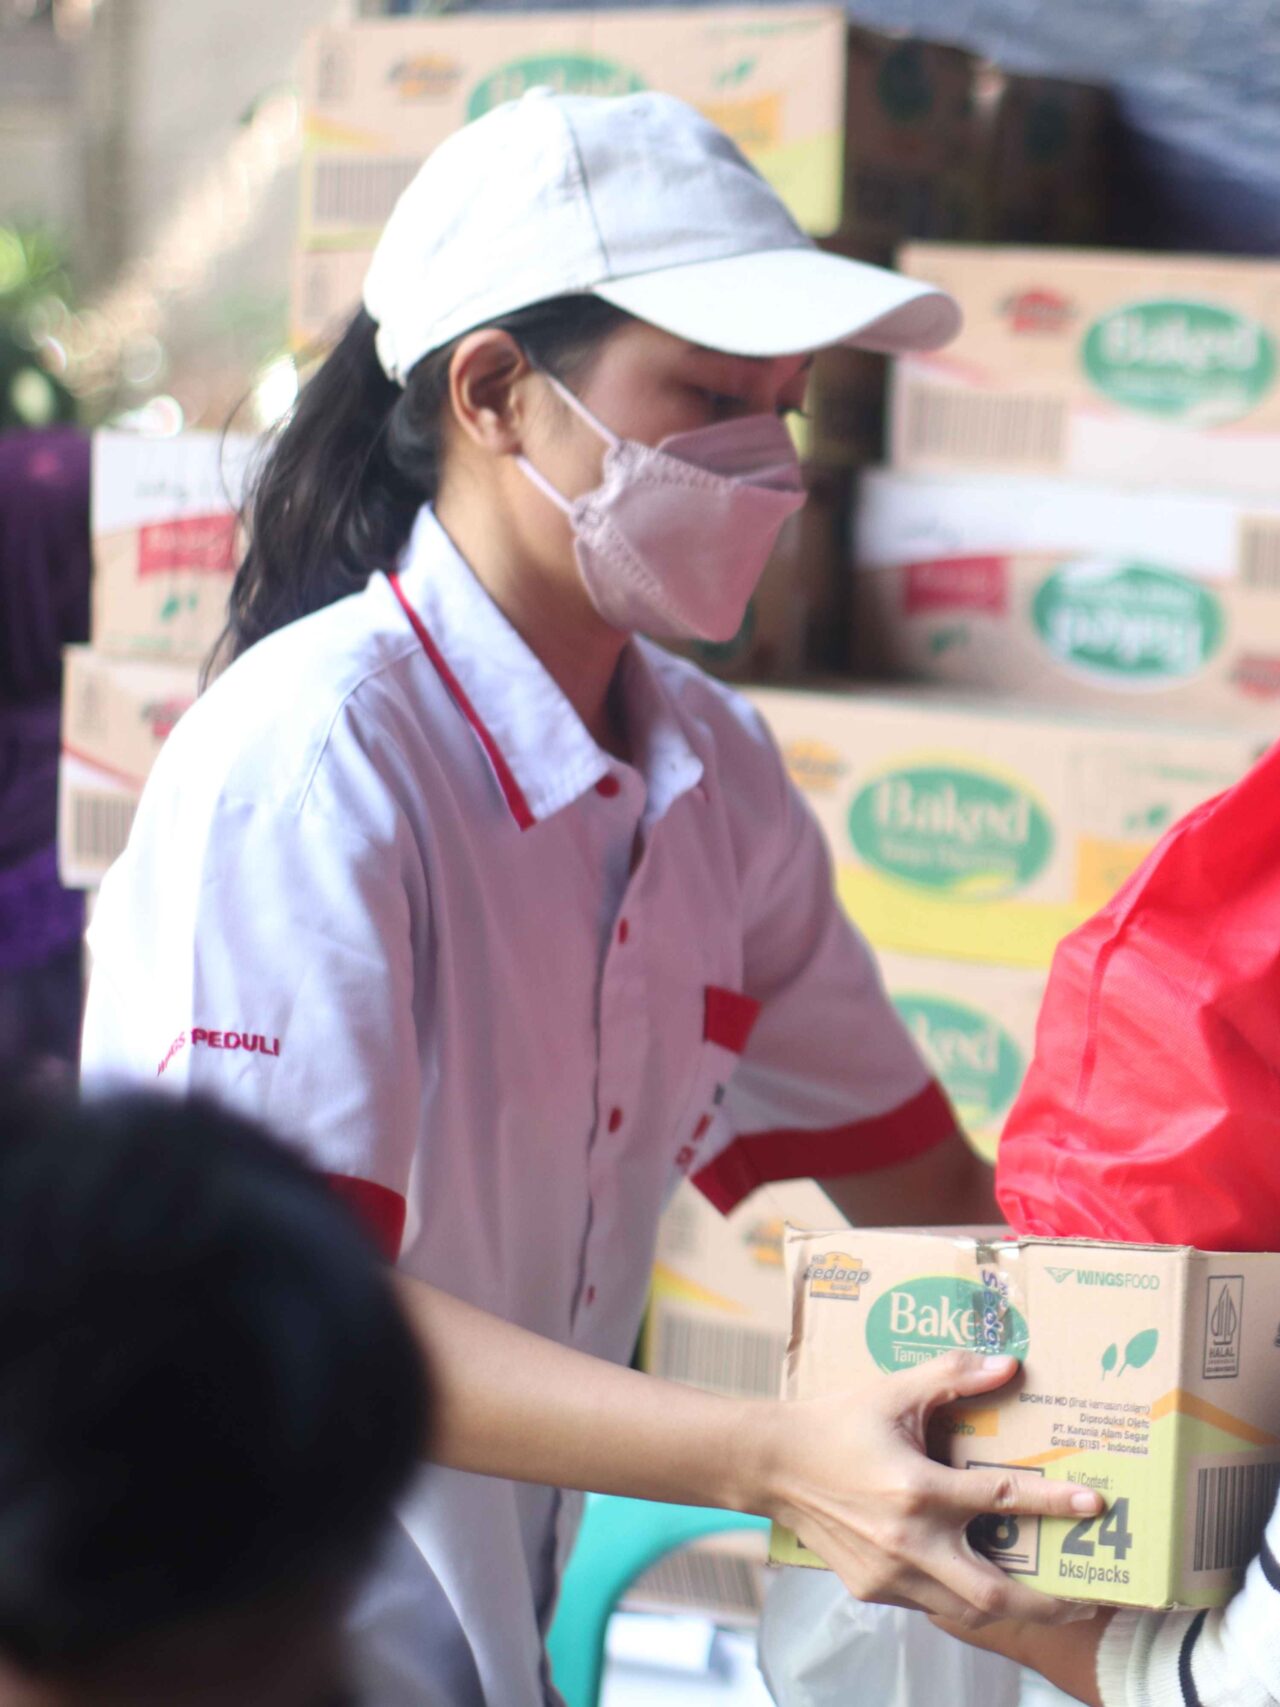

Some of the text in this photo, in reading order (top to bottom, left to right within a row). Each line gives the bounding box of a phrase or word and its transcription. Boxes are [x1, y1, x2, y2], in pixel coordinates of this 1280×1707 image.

[875, 777, 1030, 845] Baked
[191, 1028, 279, 1057] PEDULI
[908, 1010, 998, 1073] ked
[1076, 1269, 1161, 1290] WINGSFOOD
[890, 1291, 992, 1345] Bake
[982, 1269, 1003, 1347] Seda
[1053, 1423, 1149, 1442] PT. Karunia Alam Segar
[1080, 1413, 1125, 1428] Diproduksi
[1051, 1436, 1076, 1447] Gresik
[1107, 1442, 1148, 1455] Indonesia
[1061, 1496, 1133, 1560] 24
[1059, 1558, 1130, 1584] bks/packs
